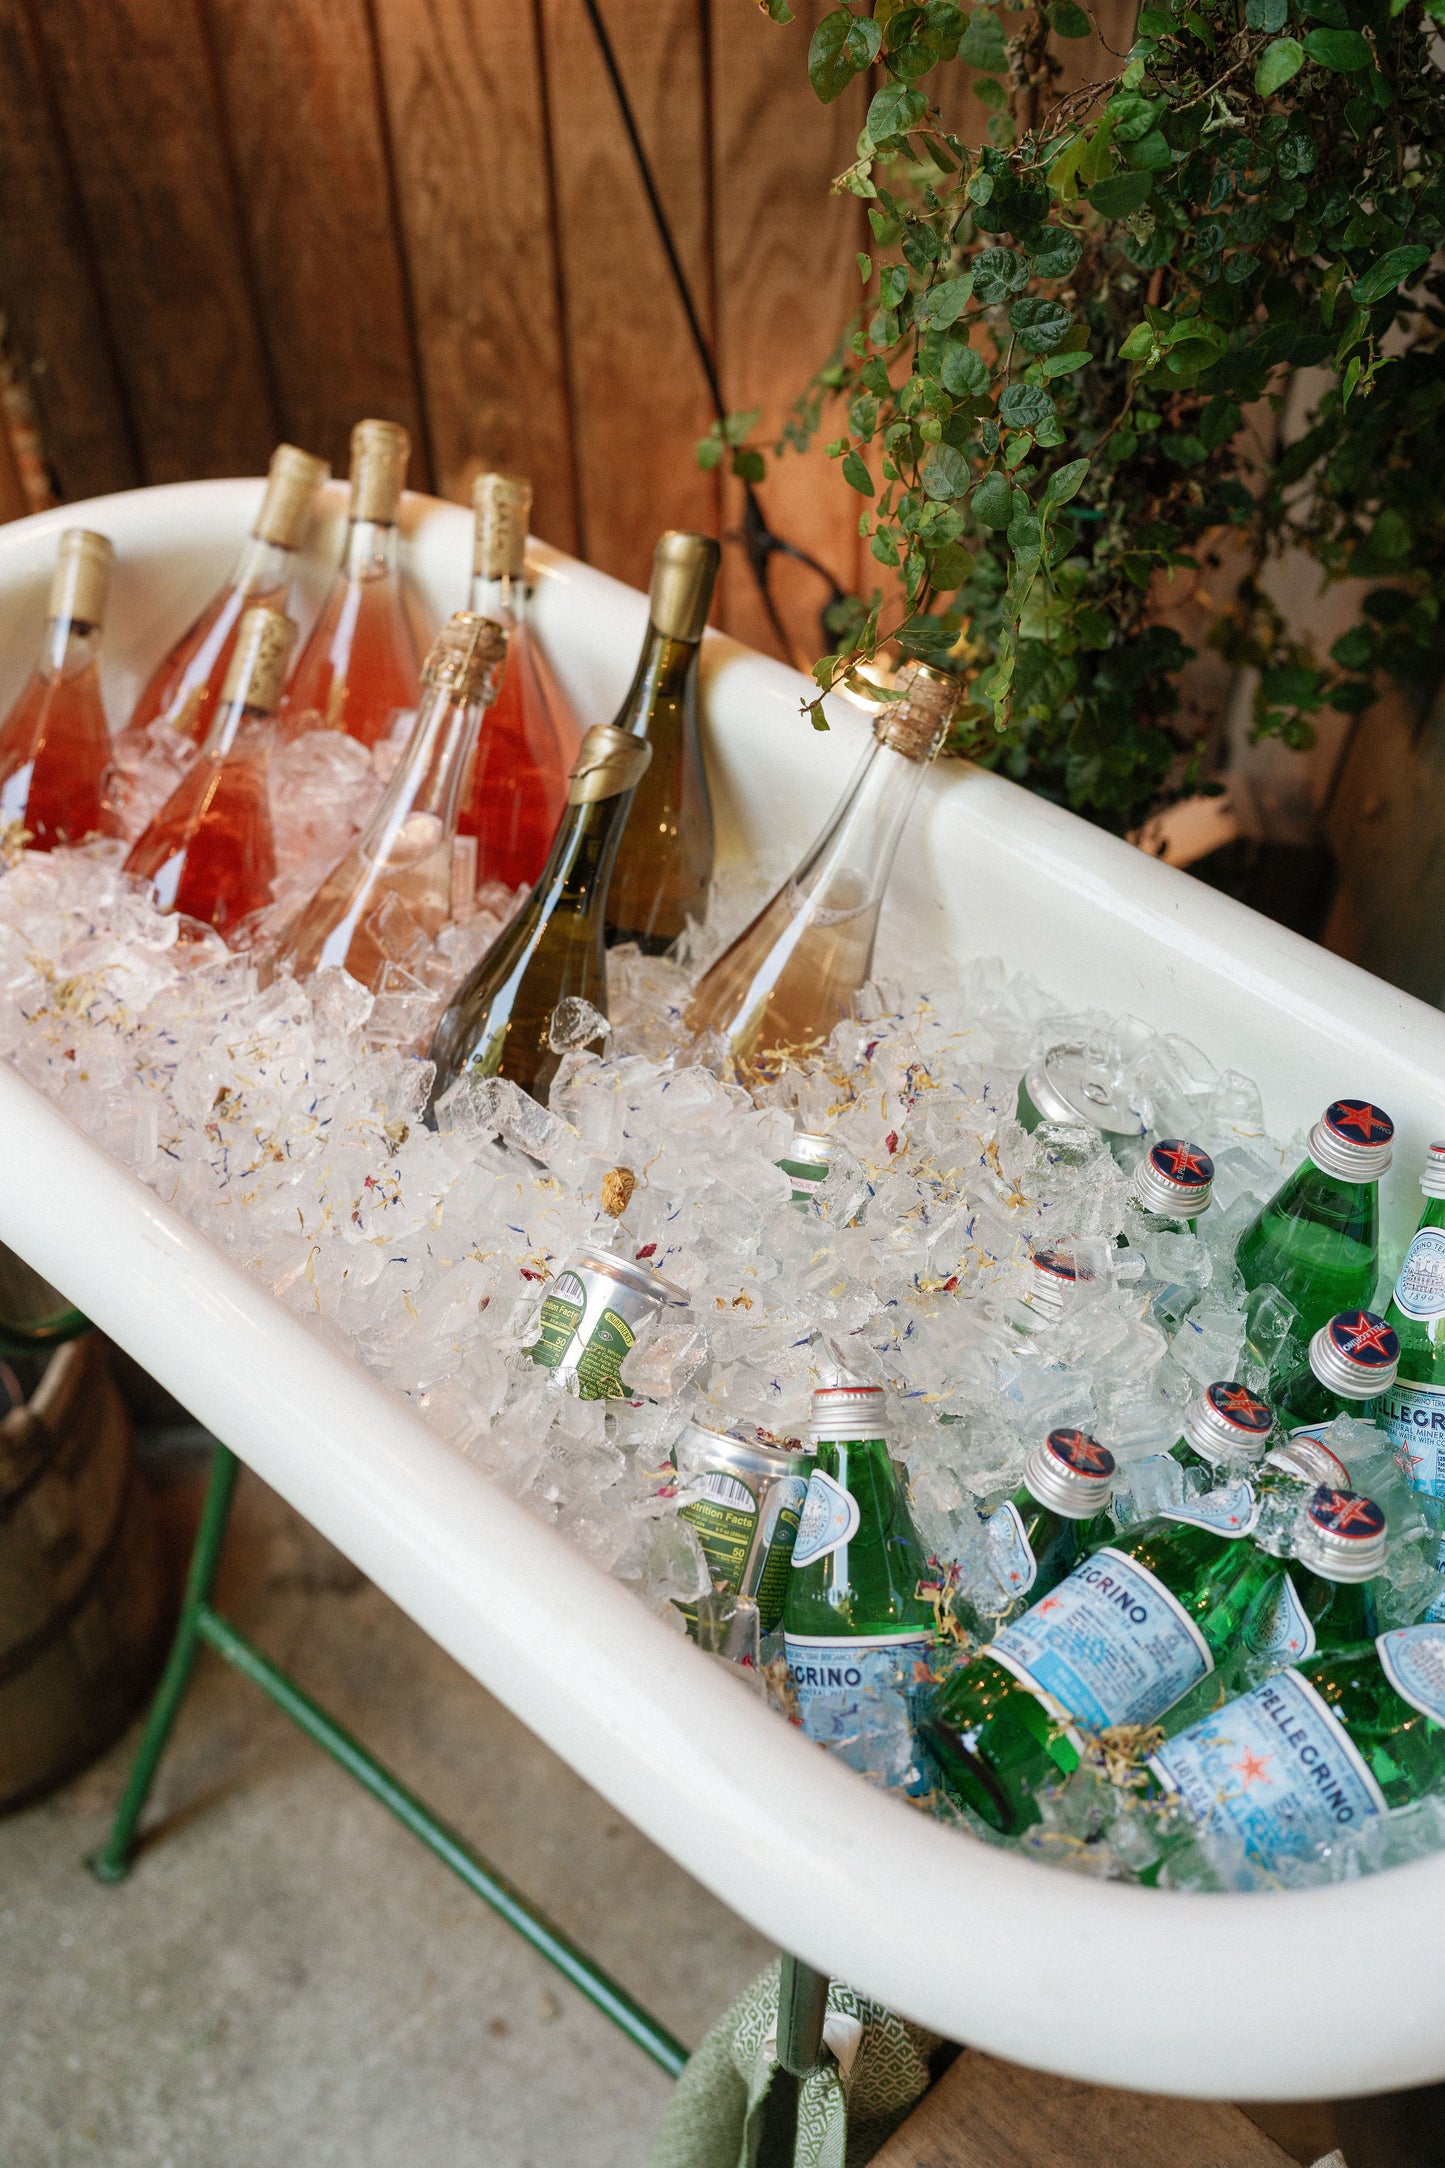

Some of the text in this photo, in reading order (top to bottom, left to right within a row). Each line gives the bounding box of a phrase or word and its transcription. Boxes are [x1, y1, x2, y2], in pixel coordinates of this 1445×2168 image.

[559, 1306, 575, 1319] Fact
[607, 1313, 631, 1344] INGREDIENTS
[555, 1336, 567, 1347] 50
[1400, 1431, 1417, 1441] WATER
[1419, 1436, 1434, 1445] WITH
[1416, 1427, 1445, 1440] MINER
[725, 1511, 753, 1528] Facts
[731, 1546, 745, 1558] 50
[1256, 1688, 1354, 1824] PELLEGRINO
